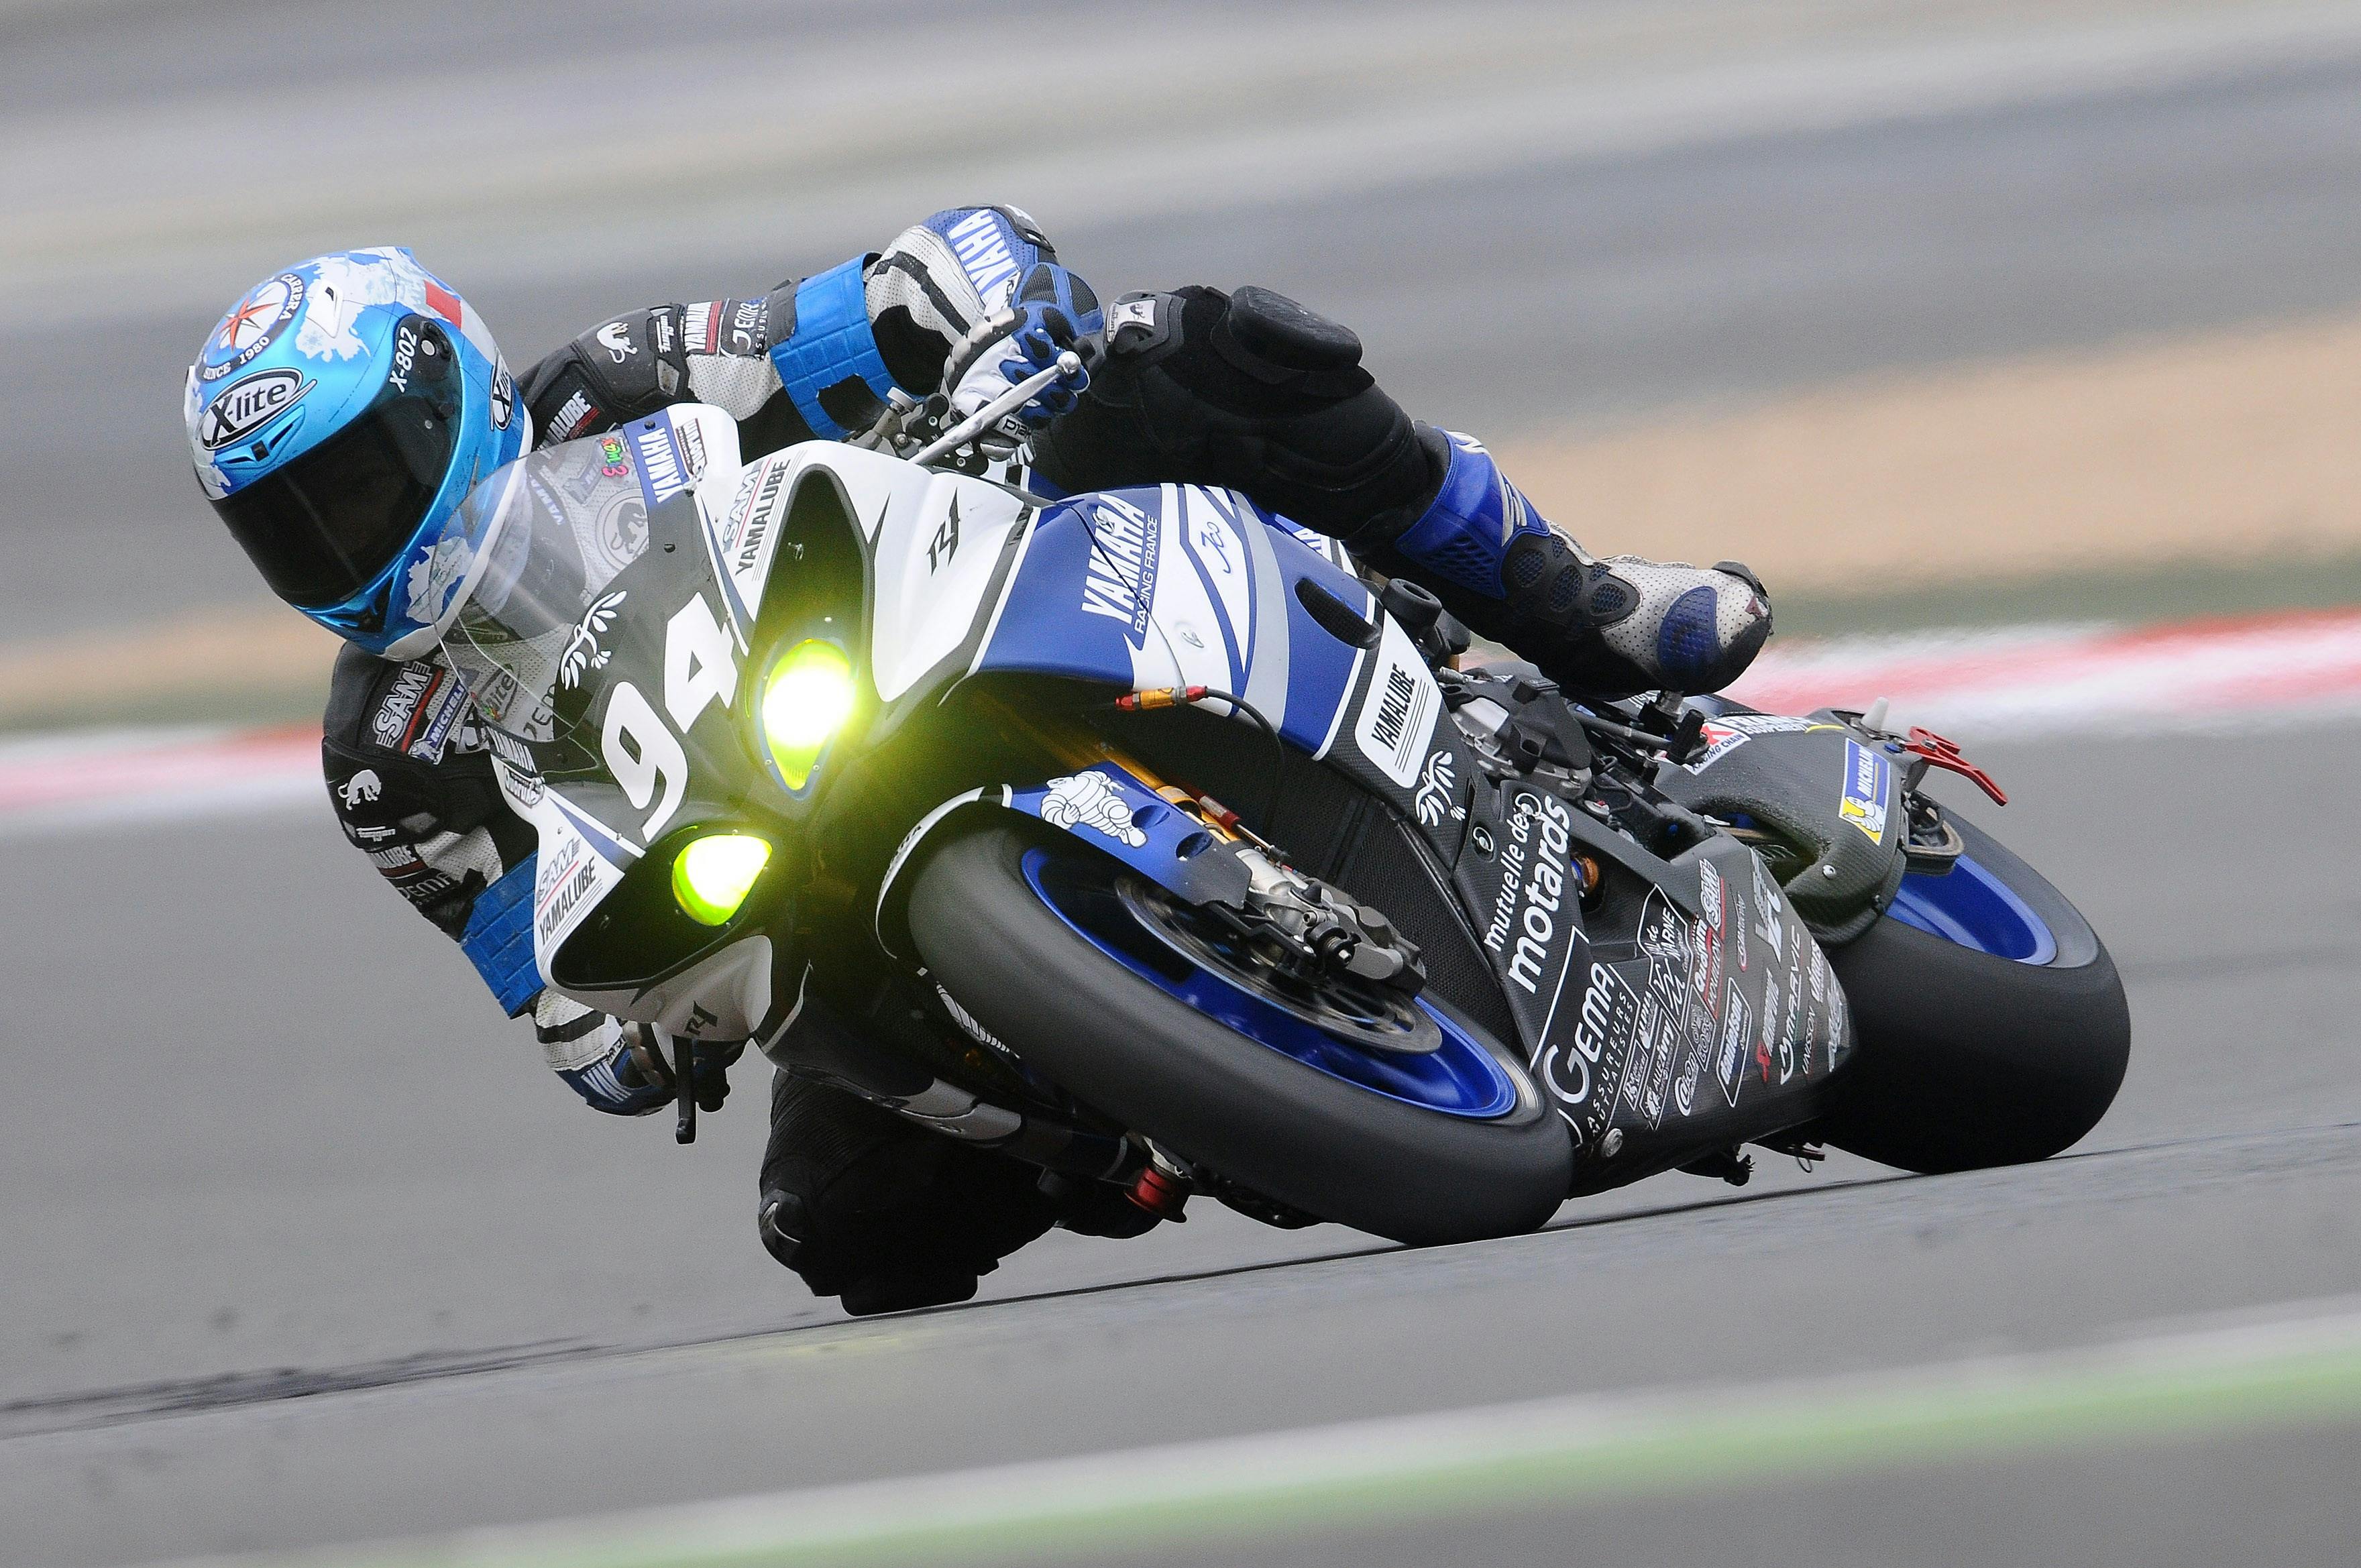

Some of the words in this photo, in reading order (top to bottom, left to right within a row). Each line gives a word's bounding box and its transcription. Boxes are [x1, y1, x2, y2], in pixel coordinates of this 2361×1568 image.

[203, 361, 232, 381] SINCE
[238, 335, 271, 364] 1980
[389, 327, 417, 393] X-802
[209, 377, 288, 445] X-lite
[639, 428, 685, 503] YAMAHA
[735, 459, 790, 575] YAMALUBE
[1143, 514, 1158, 571] FRANCE
[1081, 493, 1146, 624] YAMAHA
[1134, 570, 1155, 634] RACING
[376, 664, 431, 747] SAM
[429, 684, 465, 748] MICHELI
[601, 591, 738, 842] 94
[1372, 663, 1415, 751] YAMALUBE
[1721, 732, 1745, 750] CHAIN
[1857, 746, 1875, 796] MICHELIN
[539, 856, 597, 946] YAMALUBE
[1484, 842, 1525, 952] mutuelle
[1508, 796, 1570, 993] motards
[1543, 962, 1614, 1103] GEMA
[1587, 992, 1627, 1128] ASSUREURS
[1803, 1006, 1816, 1074] UNISSON
